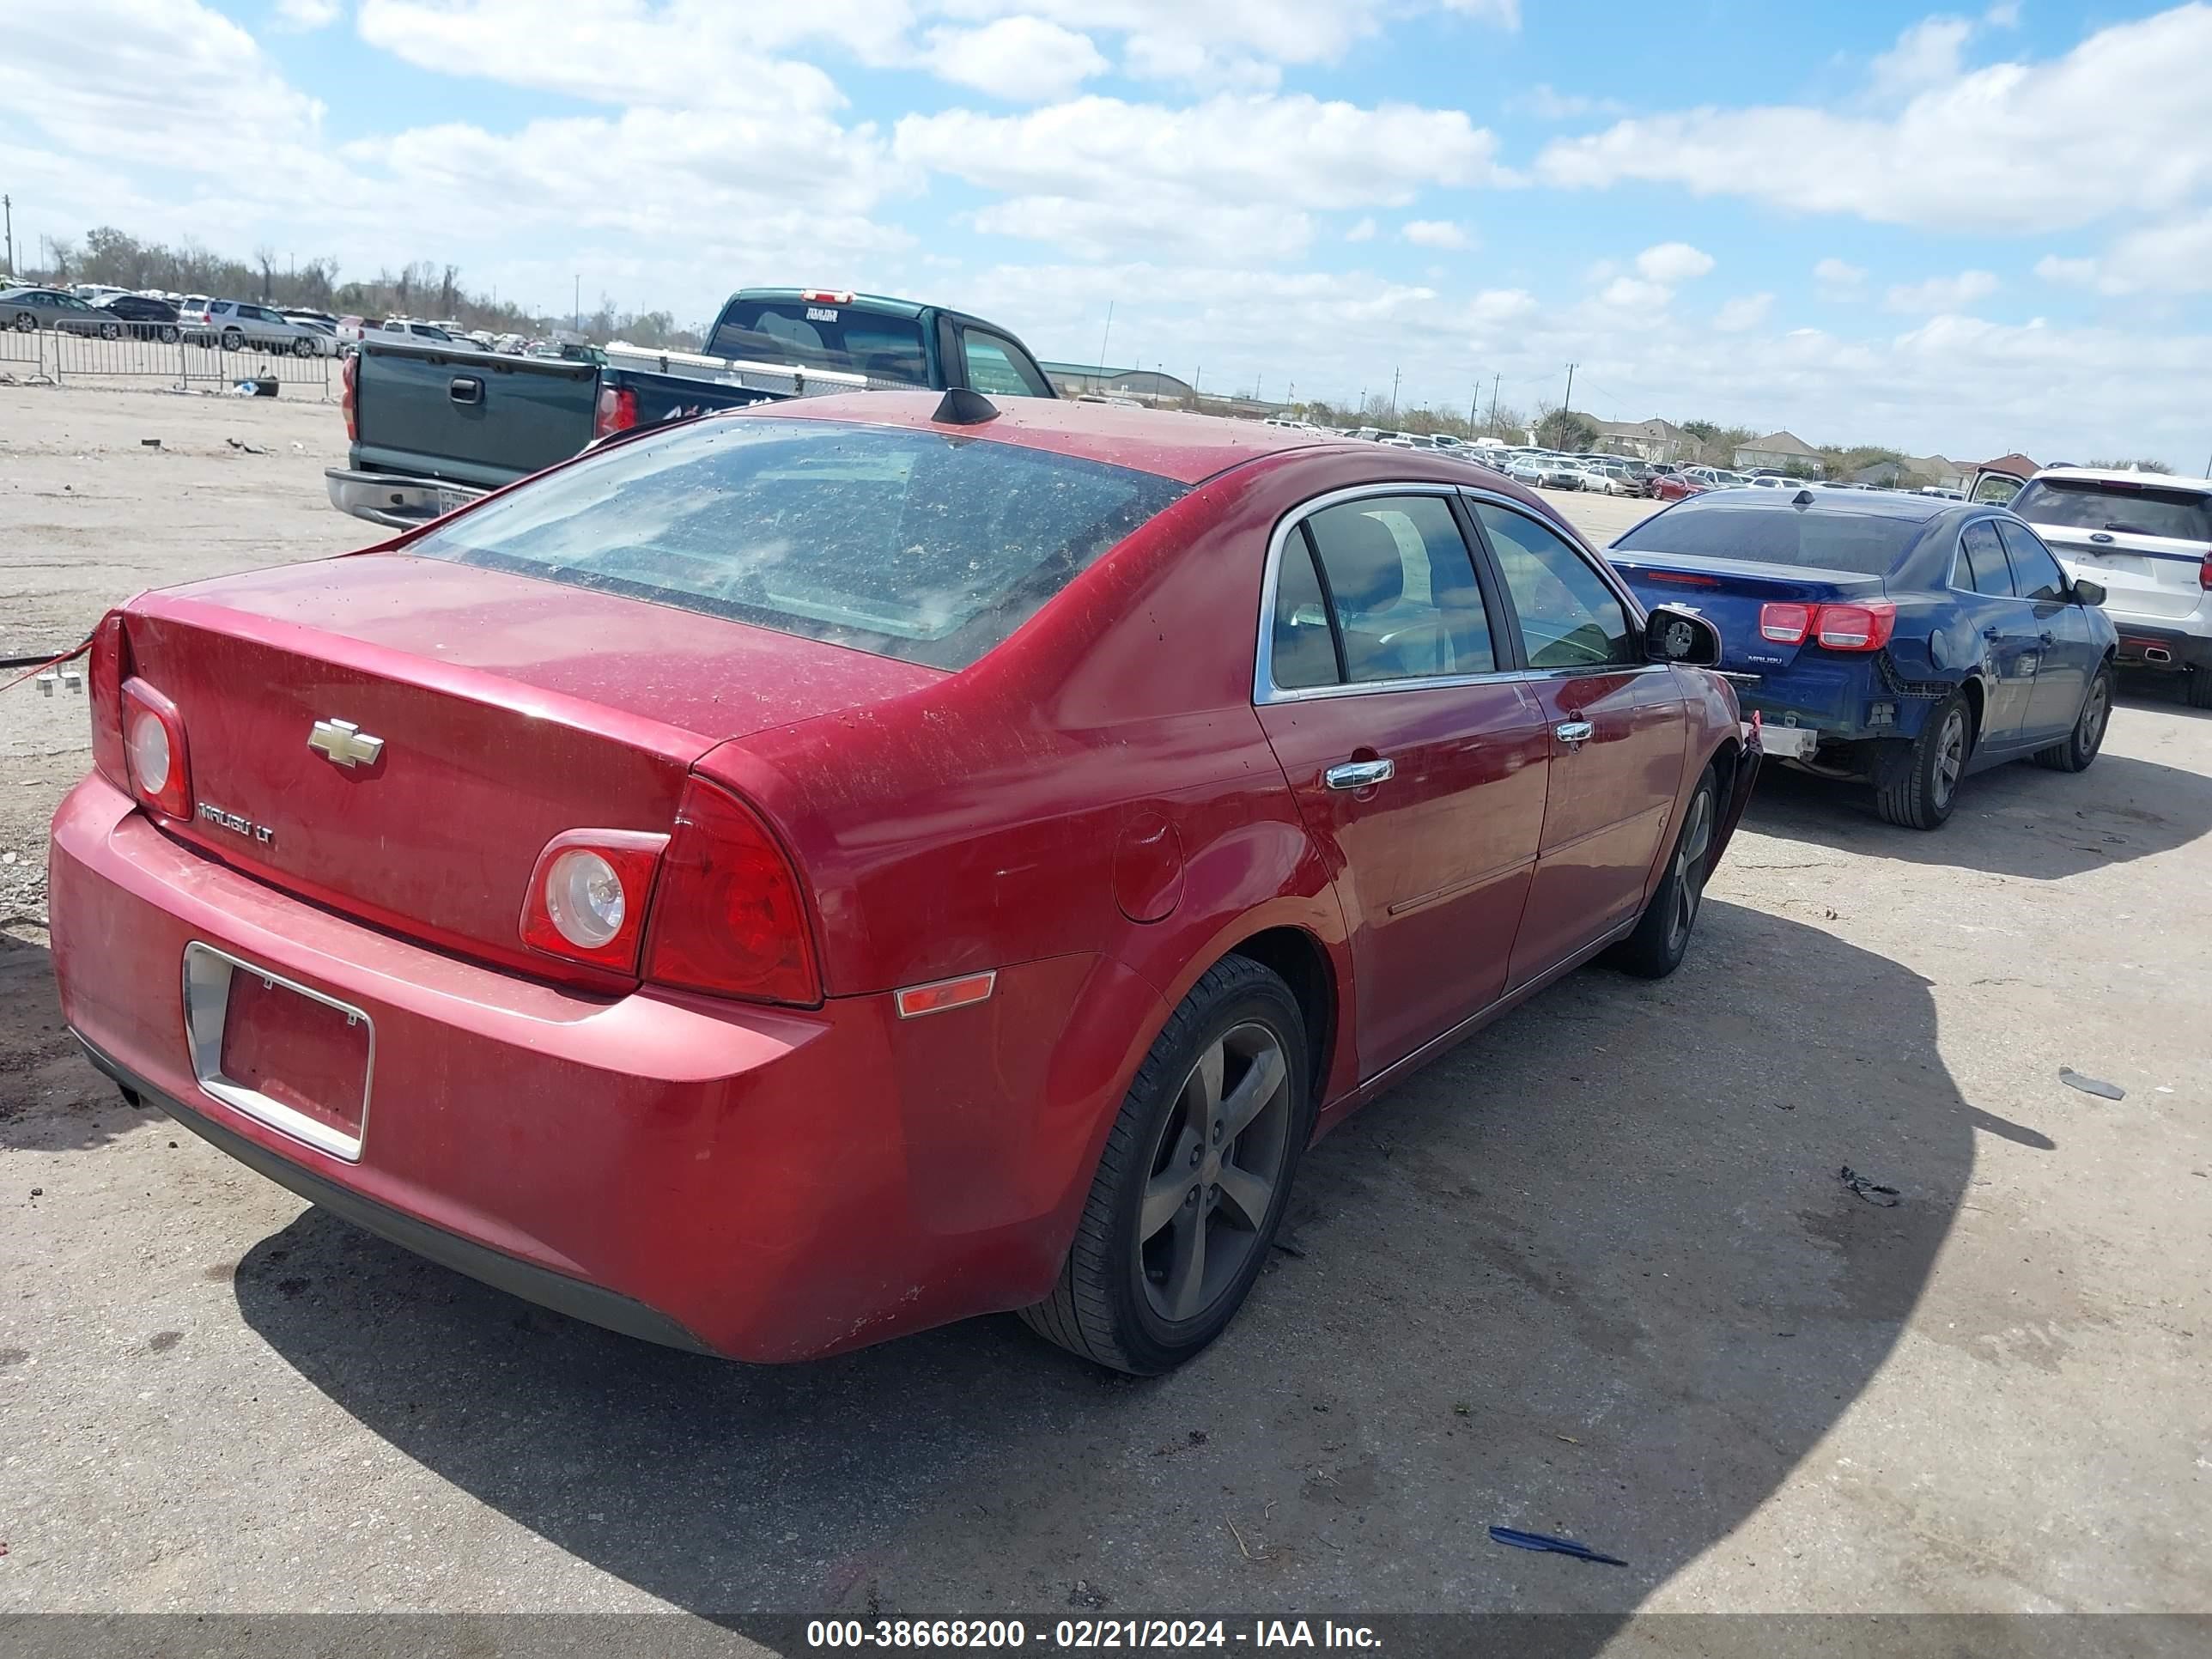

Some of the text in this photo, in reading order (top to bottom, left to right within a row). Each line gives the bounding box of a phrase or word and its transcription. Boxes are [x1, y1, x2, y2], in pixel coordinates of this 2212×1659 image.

[1747, 655, 1783, 665] MALIBU
[198, 802, 273, 843] MALIBU LT
